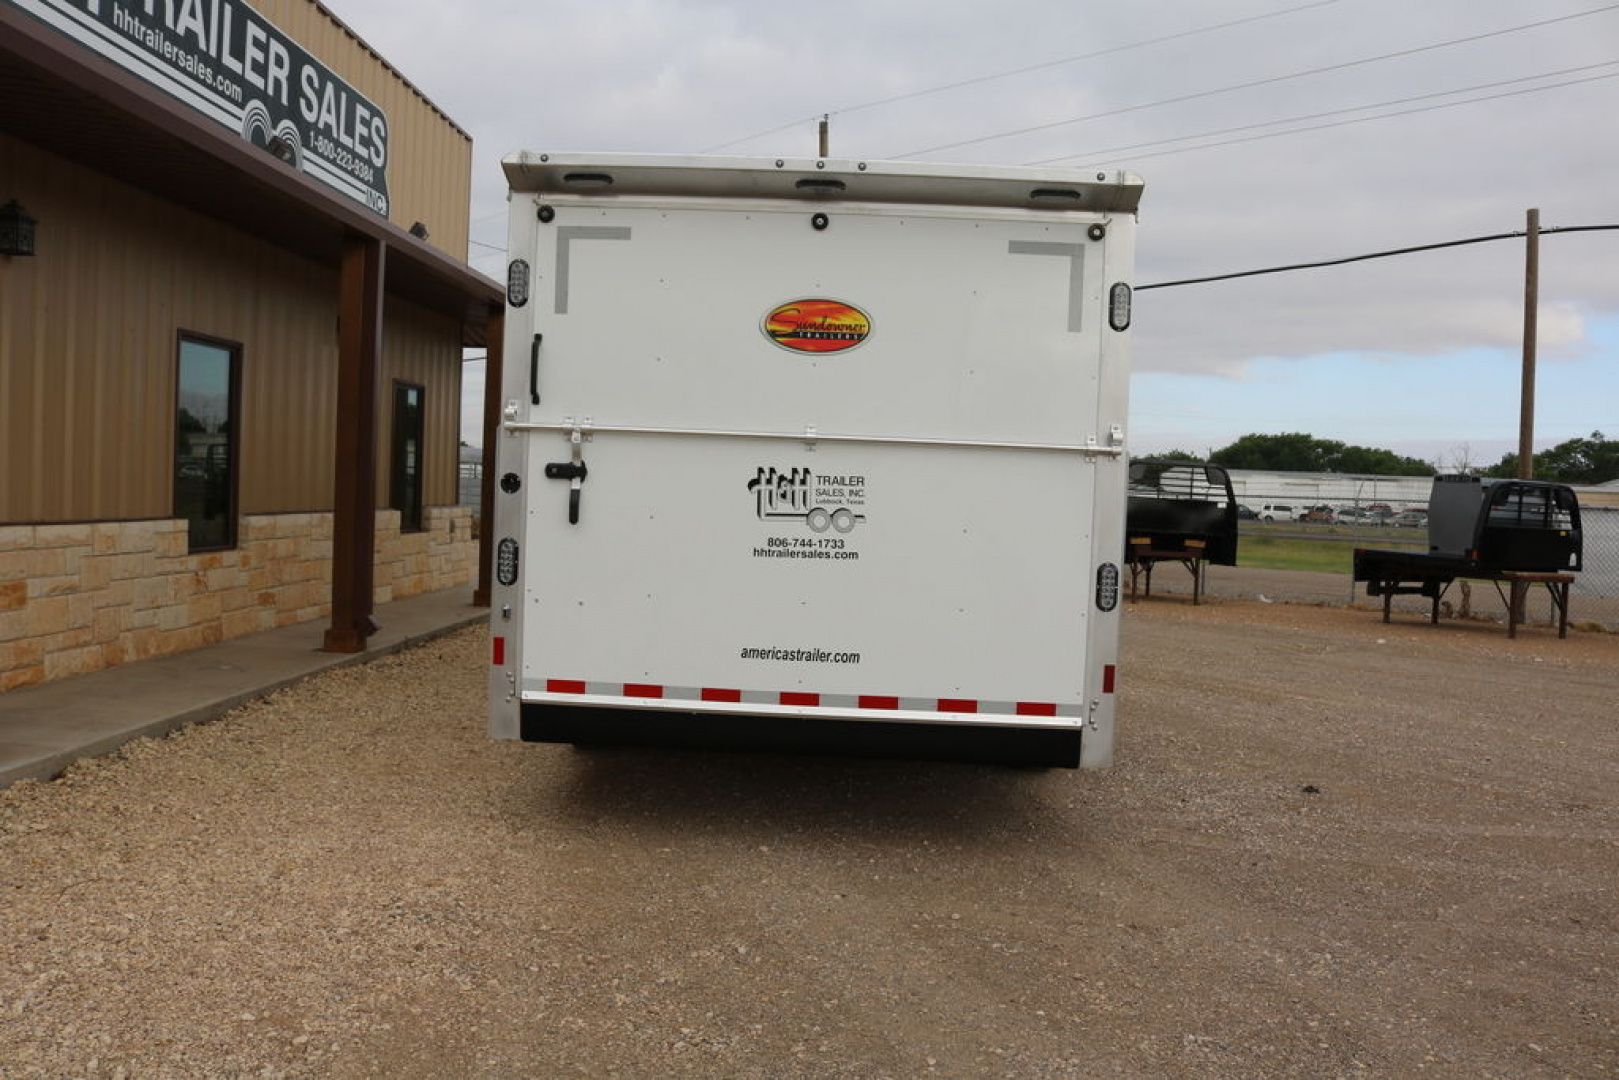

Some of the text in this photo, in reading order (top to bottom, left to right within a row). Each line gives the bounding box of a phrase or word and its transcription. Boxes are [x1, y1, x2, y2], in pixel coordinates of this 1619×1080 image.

[113, 2, 243, 102] hhtrailersales.com
[300, 64, 385, 168] SALES
[769, 308, 866, 332] Sundowner
[815, 475, 866, 486] TRAILER
[767, 537, 845, 550] 806-744-1733
[753, 546, 860, 560] hhtrailersales.com
[740, 646, 861, 664] americastrailer.com
